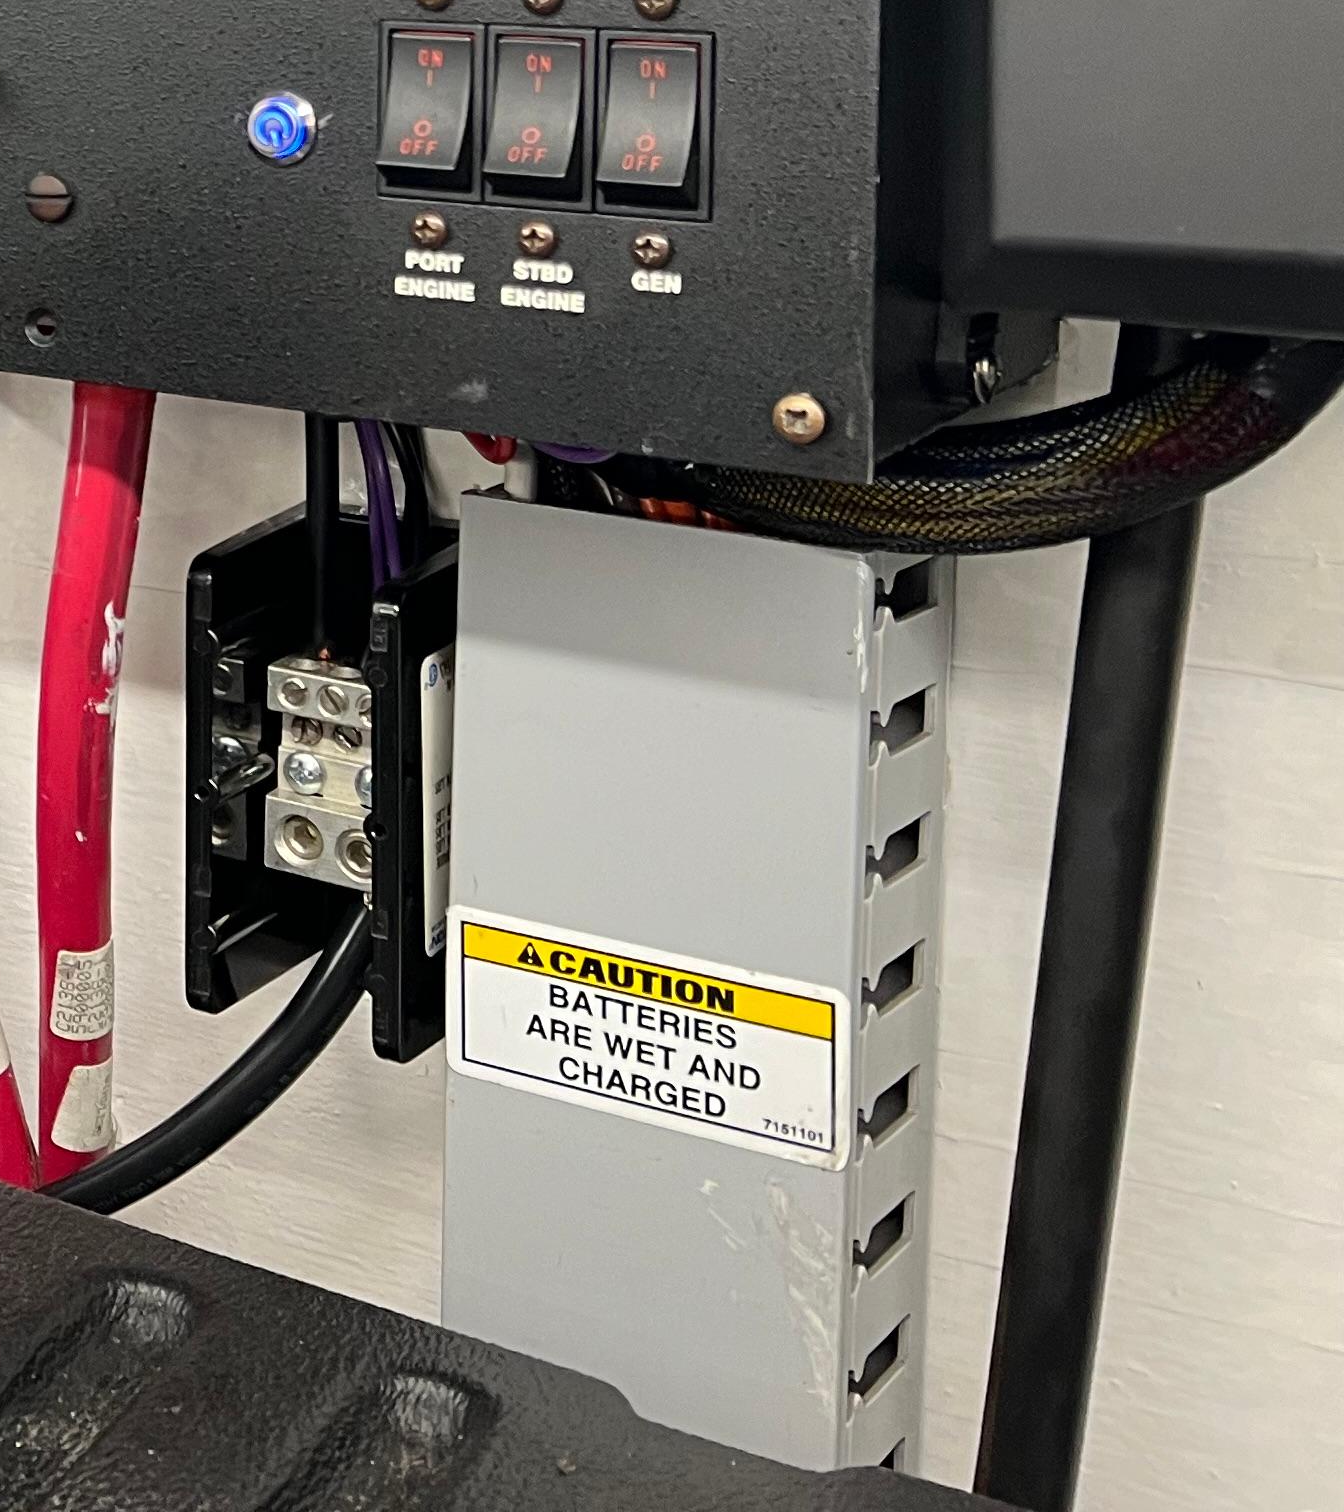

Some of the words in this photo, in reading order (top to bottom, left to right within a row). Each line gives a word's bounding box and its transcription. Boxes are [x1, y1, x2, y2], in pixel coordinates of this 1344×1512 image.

[418, 50, 443, 68] ON
[526, 54, 552, 74] ON
[640, 59, 666, 79] ON
[400, 138, 438, 156] OFF
[508, 146, 547, 164] OFF
[622, 154, 661, 173] OFF
[405, 250, 464, 273] PORT
[513, 259, 573, 283] STBD
[395, 276, 475, 301] ENGINE
[631, 270, 681, 294] GEN
[501, 286, 585, 313] ENGINE
[550, 951, 735, 1013] CAUTION
[551, 984, 738, 1049] BATTERIES
[527, 1015, 592, 1050] ARE
[604, 1033, 676, 1070] WET
[689, 1055, 760, 1089] AND
[559, 1056, 726, 1118] CHARGED
[764, 1119, 825, 1144] 7151101
